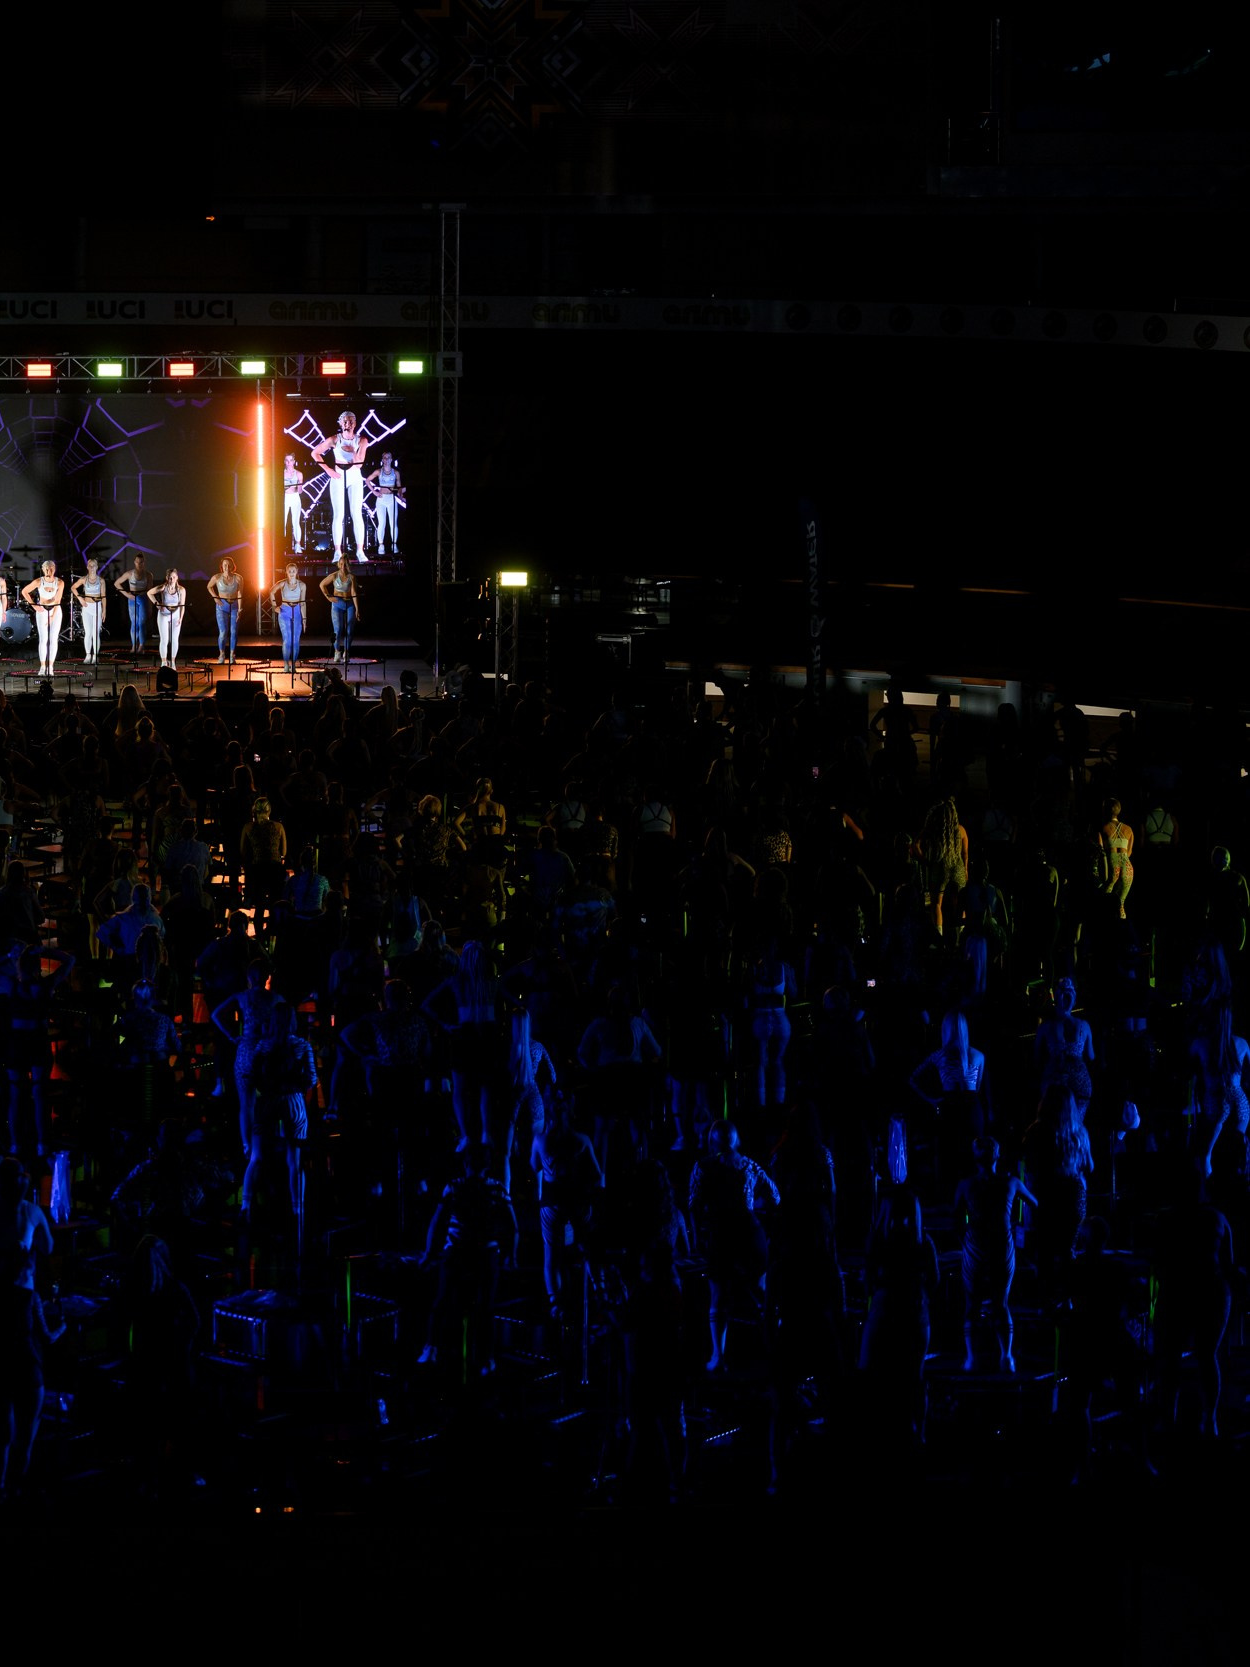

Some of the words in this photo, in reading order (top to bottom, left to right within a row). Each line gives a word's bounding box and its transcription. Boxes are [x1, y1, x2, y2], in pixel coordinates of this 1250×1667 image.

[9, 300, 58, 320] UCI
[98, 300, 146, 320] UCI
[185, 300, 234, 320] UCI
